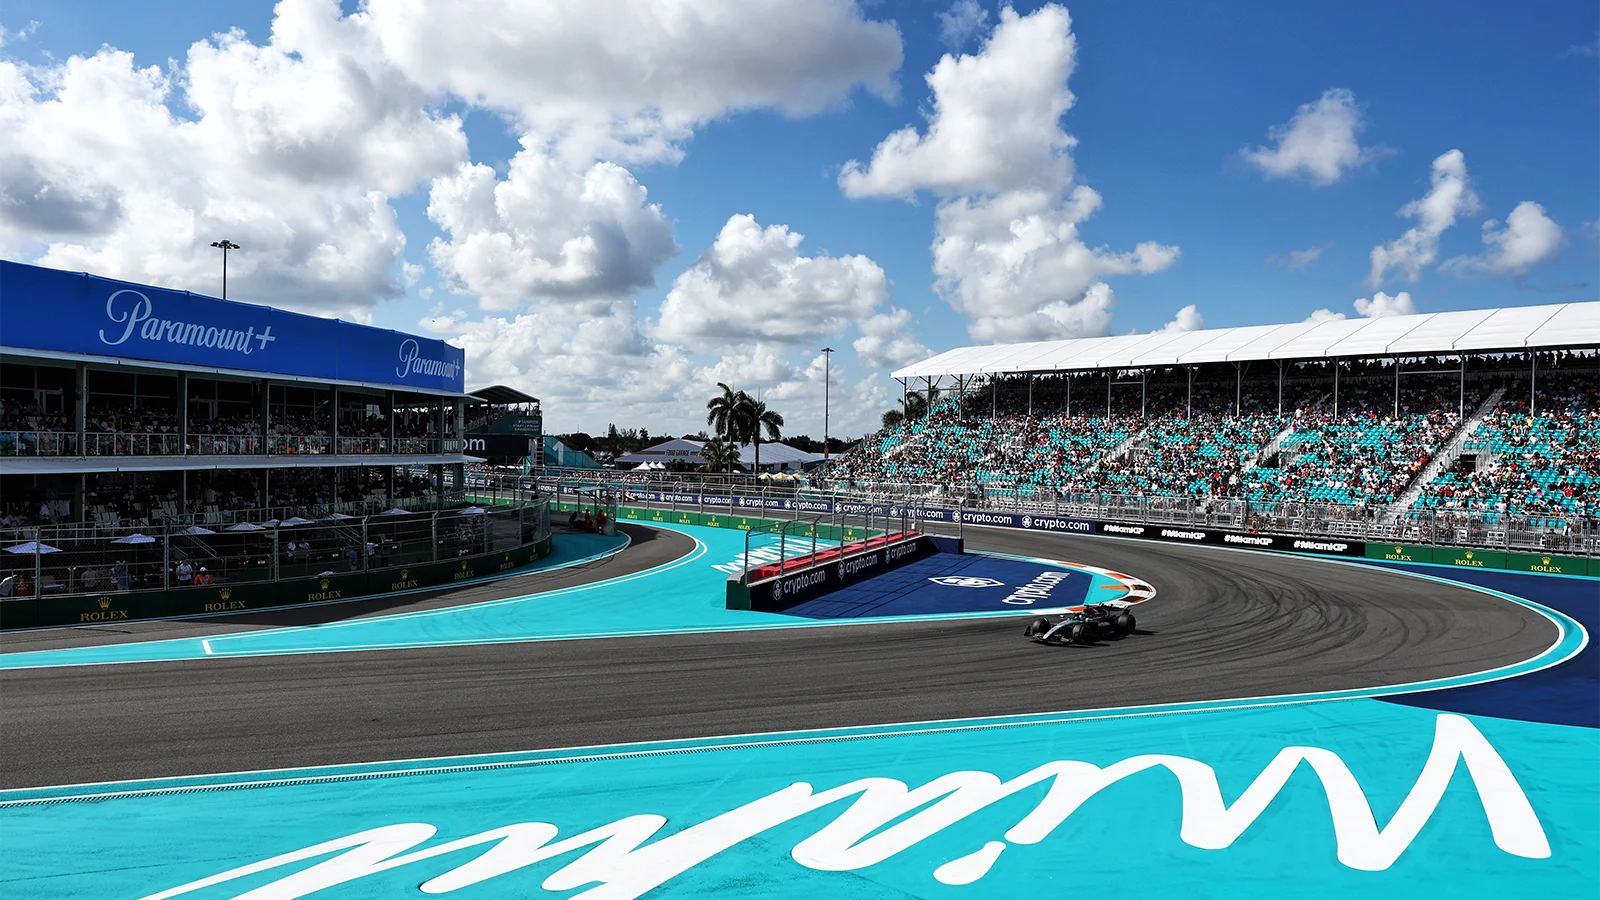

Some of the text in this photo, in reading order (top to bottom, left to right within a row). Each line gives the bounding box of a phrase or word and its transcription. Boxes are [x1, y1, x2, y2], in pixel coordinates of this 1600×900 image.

[99, 289, 276, 355] Paramount+
[395, 338, 461, 381] Paramount+
[552, 440, 564, 466] 1
[963, 511, 1012, 526] crypto.com
[1034, 518, 1090, 532] crypto.com
[1385, 553, 1412, 561] ROLEX
[1454, 559, 1483, 567] ROLEX
[845, 554, 878, 574] crypto.com
[1530, 565, 1562, 573] ROLEX
[454, 570, 475, 580] ROLEX
[783, 569, 826, 594] crypto.com
[391, 579, 418, 591] ROLEX
[1002, 571, 1070, 606] crypto.com
[308, 590, 342, 602] ROLEX
[204, 600, 246, 612] ROLEX
[80, 609, 128, 622] ROLEX
